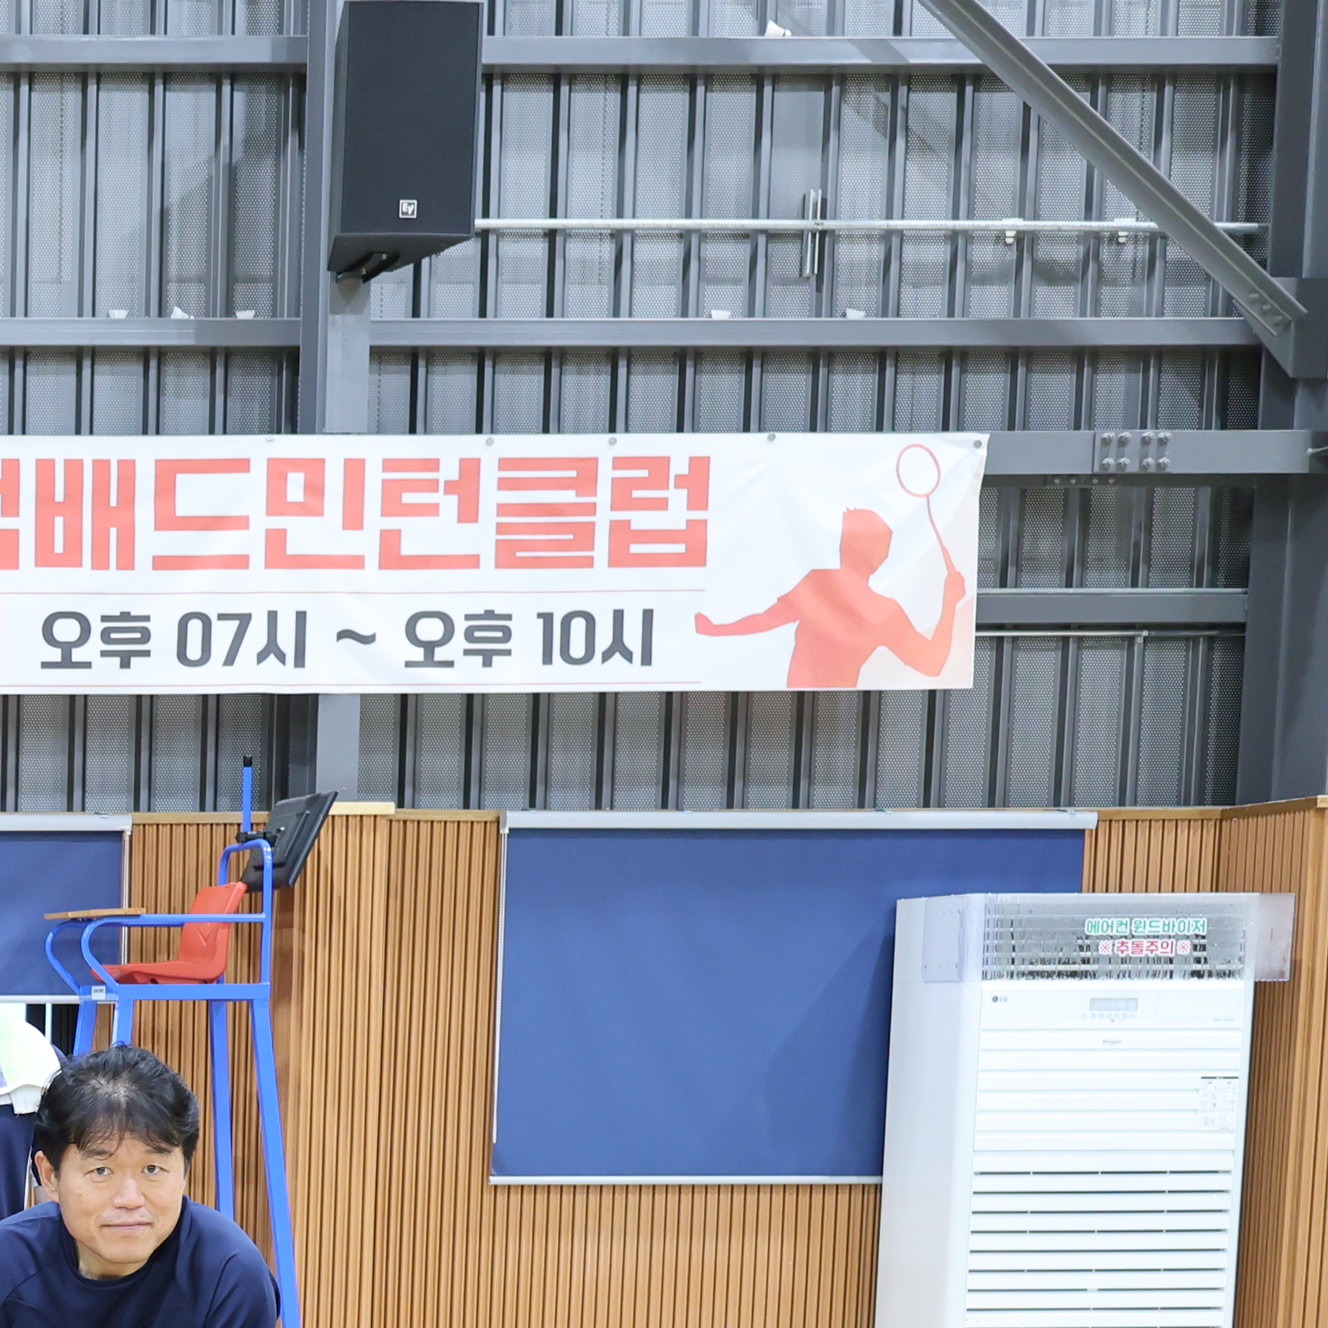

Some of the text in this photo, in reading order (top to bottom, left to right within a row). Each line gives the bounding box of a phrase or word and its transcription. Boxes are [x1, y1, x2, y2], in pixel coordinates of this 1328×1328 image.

[40, 610, 152, 670] 오후
[176, 609, 308, 669] 07시
[403, 609, 513, 669] 오후
[536, 608, 655, 667] 10시
[1086, 919, 1206, 934] 에어컨 윈드바이저
[1115, 940, 1175, 955] 추돌주의
